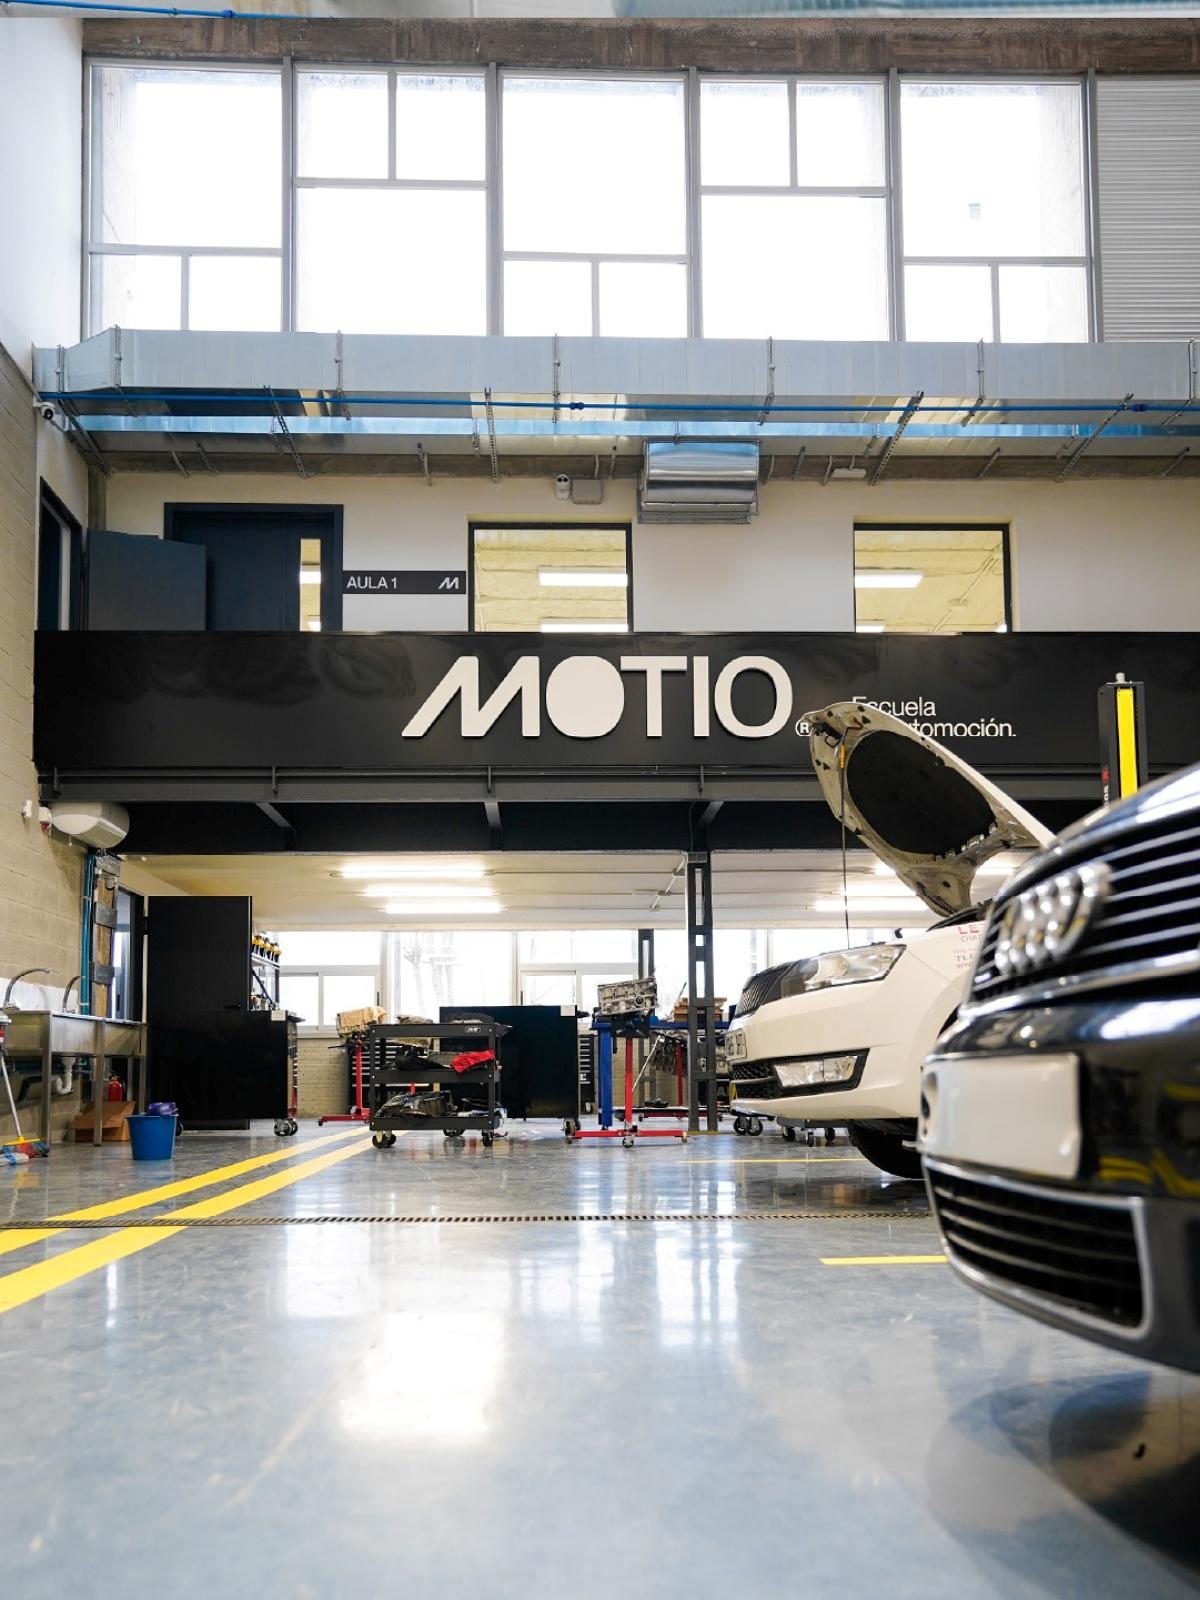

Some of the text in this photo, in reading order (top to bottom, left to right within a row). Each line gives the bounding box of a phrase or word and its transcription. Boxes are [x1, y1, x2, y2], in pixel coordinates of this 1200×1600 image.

[346, 576, 397, 589] AULA 1
[401, 655, 793, 738] MOTIO
[908, 718, 1016, 737] tomoción.
